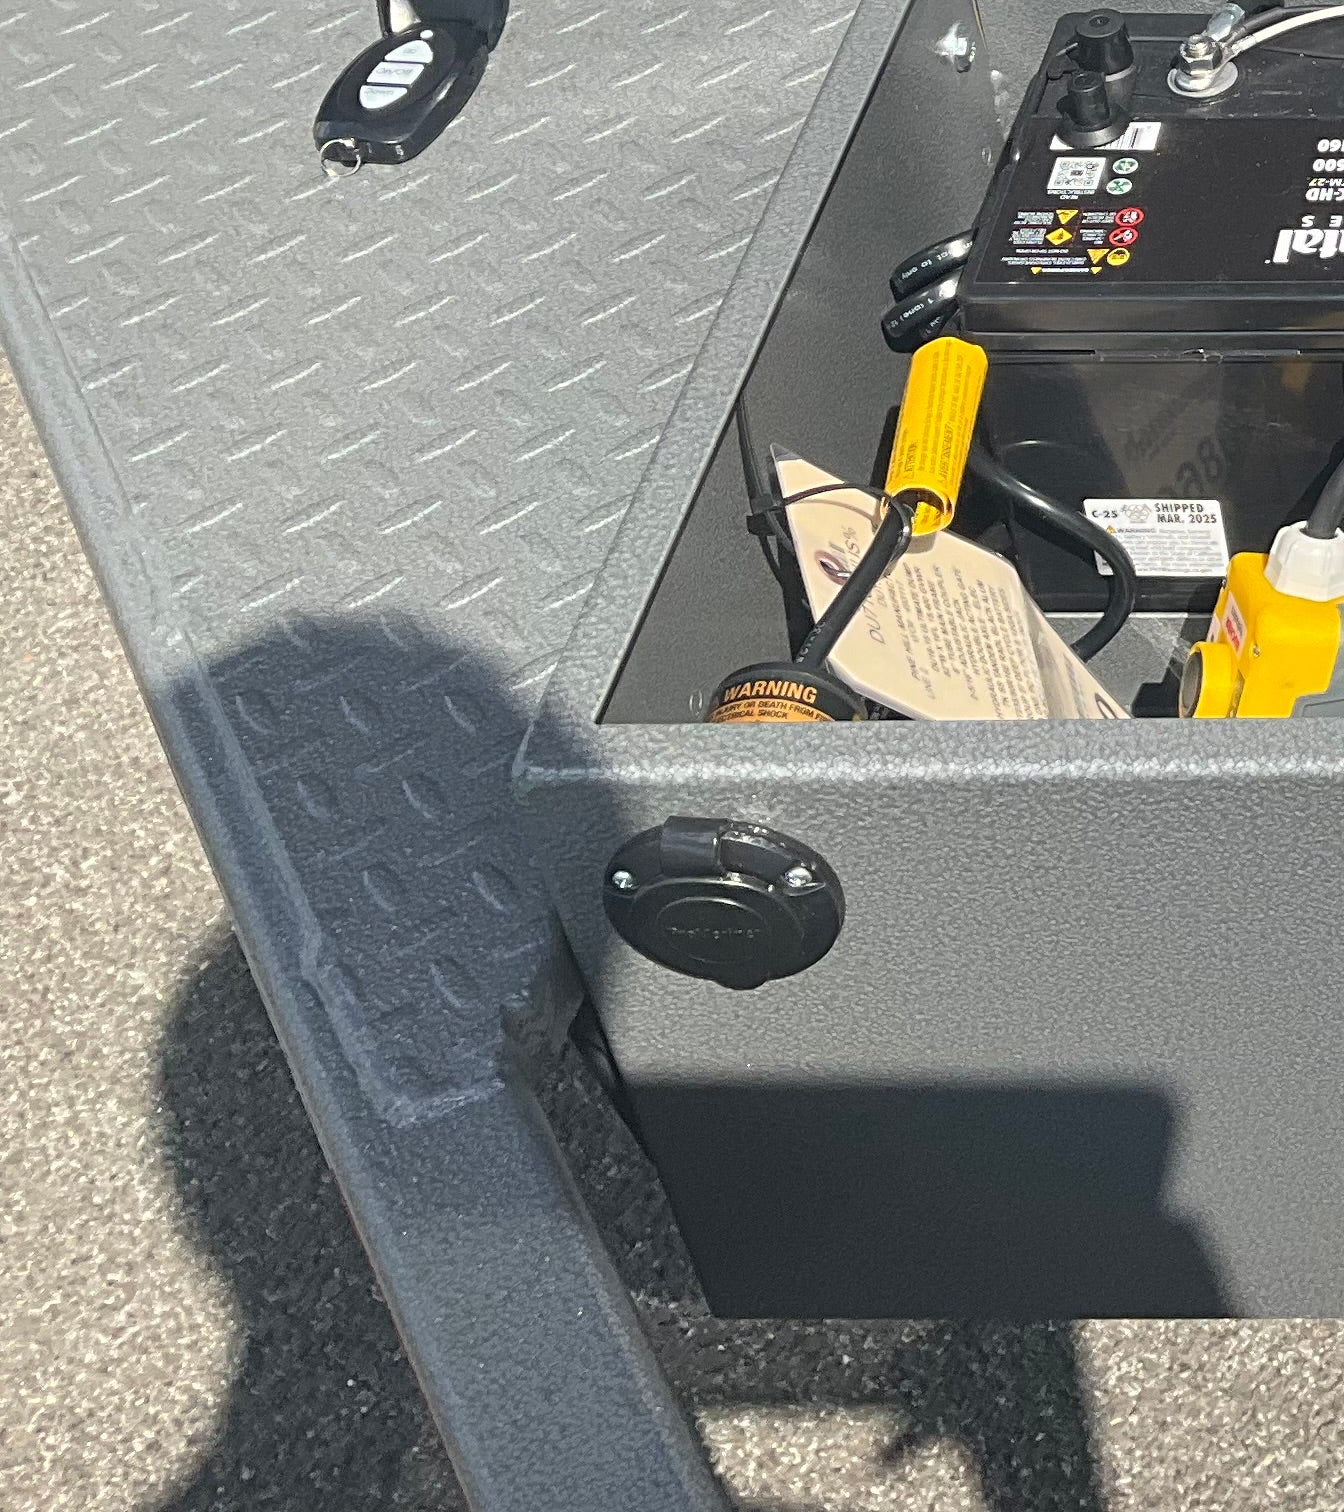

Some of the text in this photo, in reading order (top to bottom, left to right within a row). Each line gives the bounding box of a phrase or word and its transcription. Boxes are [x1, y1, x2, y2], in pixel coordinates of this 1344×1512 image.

[1154, 503, 1204, 513] SHIPPED
[1091, 510, 1118, 518] C-25
[1157, 514, 1217, 523] MAR. 2025
[724, 680, 818, 704] WARNING
[758, 700, 787, 709] DEATH
[789, 704, 814, 716] FROM
[758, 710, 788, 719] SHOCK
